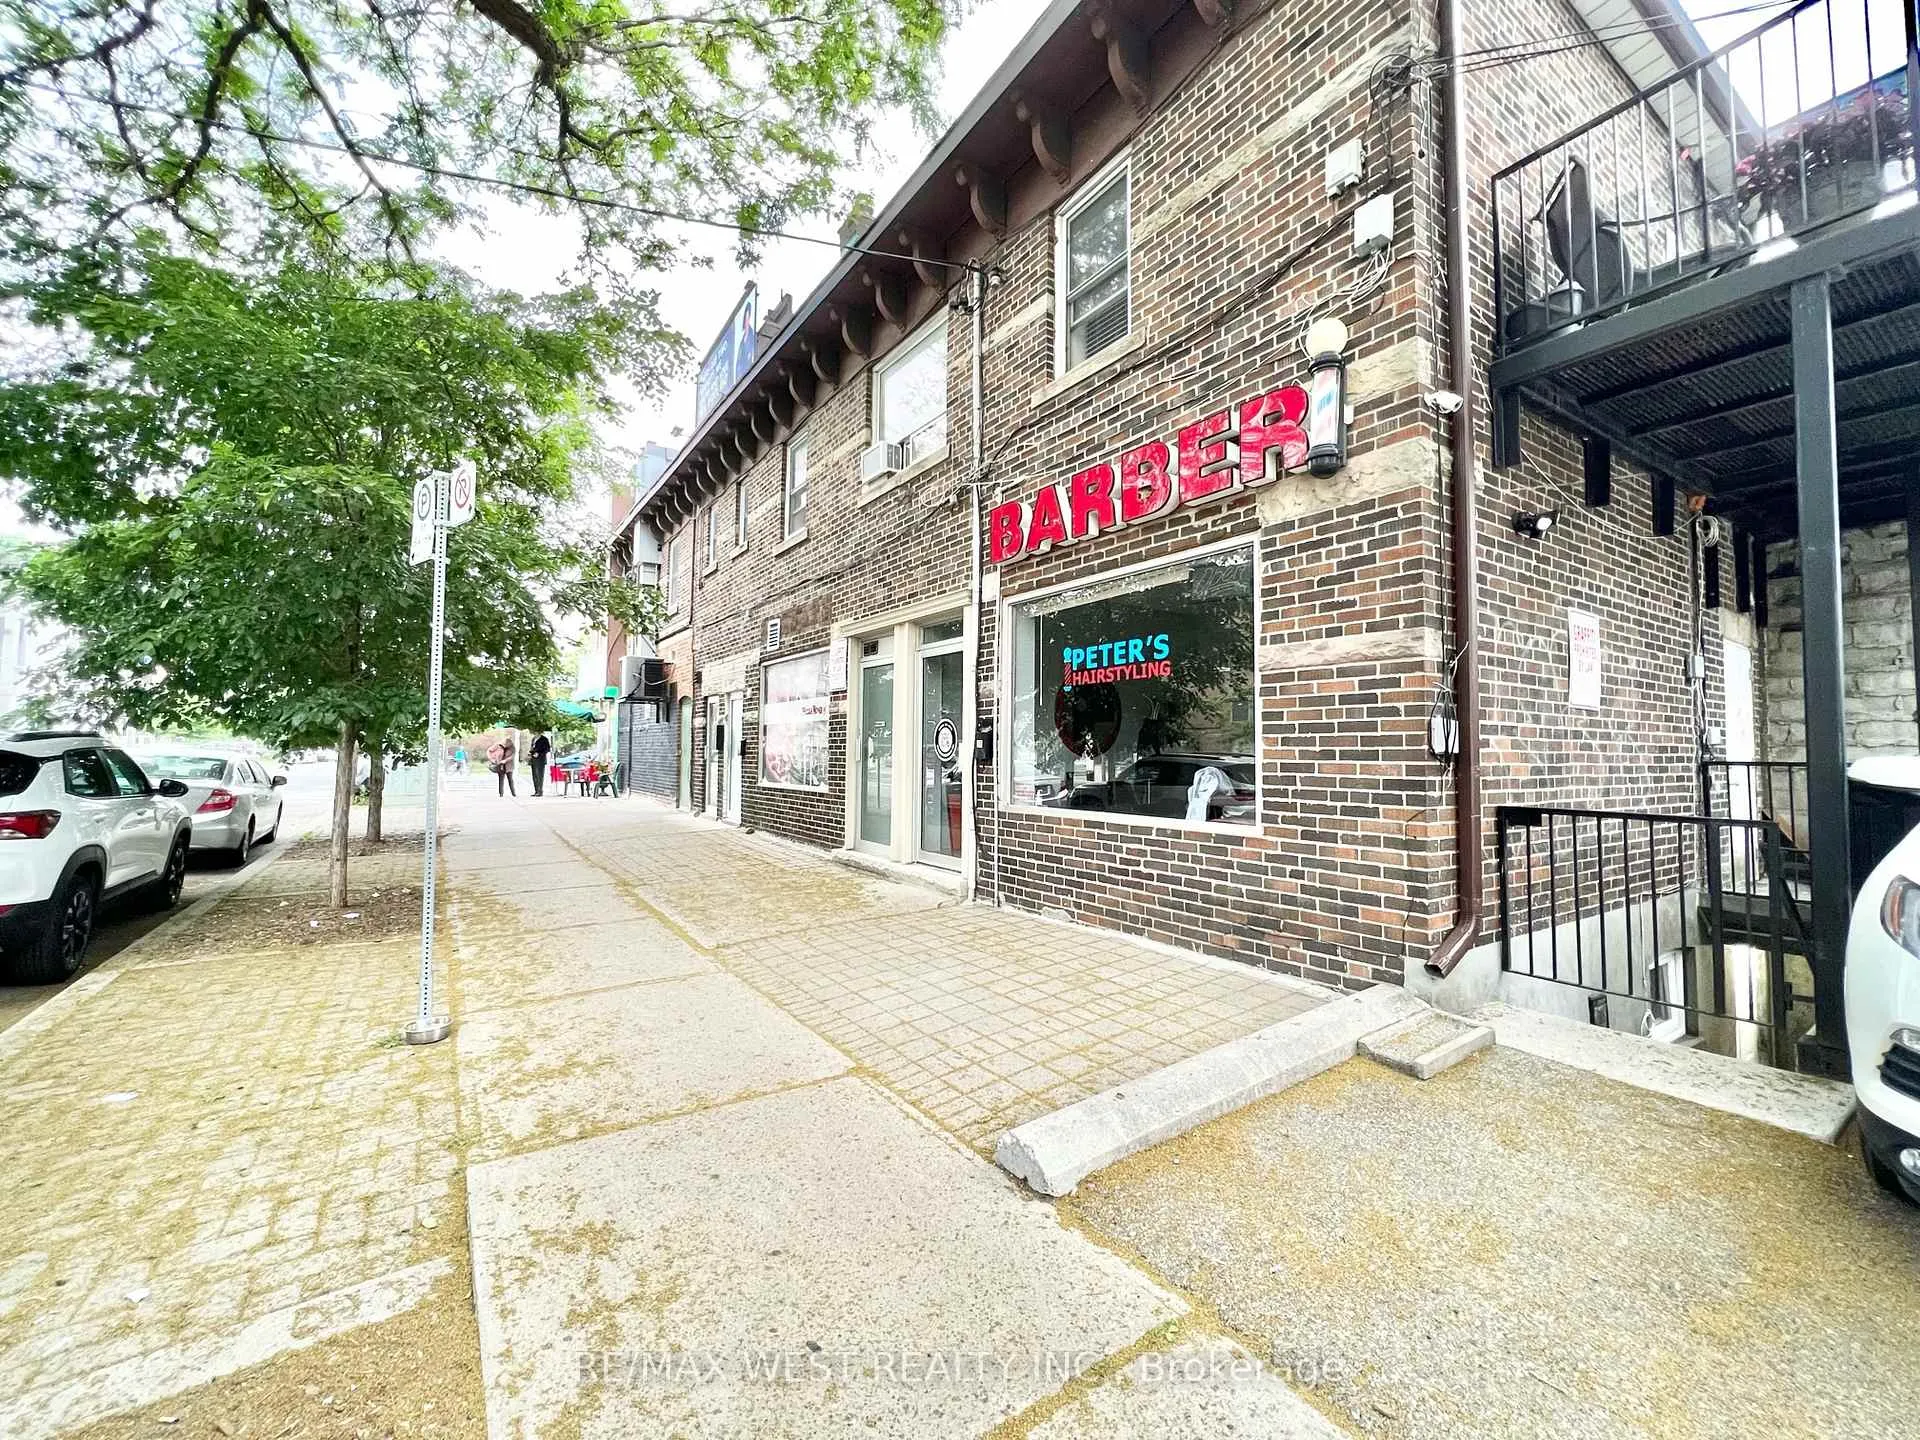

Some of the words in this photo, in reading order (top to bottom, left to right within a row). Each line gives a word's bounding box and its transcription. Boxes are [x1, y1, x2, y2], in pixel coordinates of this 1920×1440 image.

[989, 384, 1310, 565] BARBER
[1072, 633, 1169, 671] PETER'S
[1072, 660, 1172, 686] HAIRSTYLING
